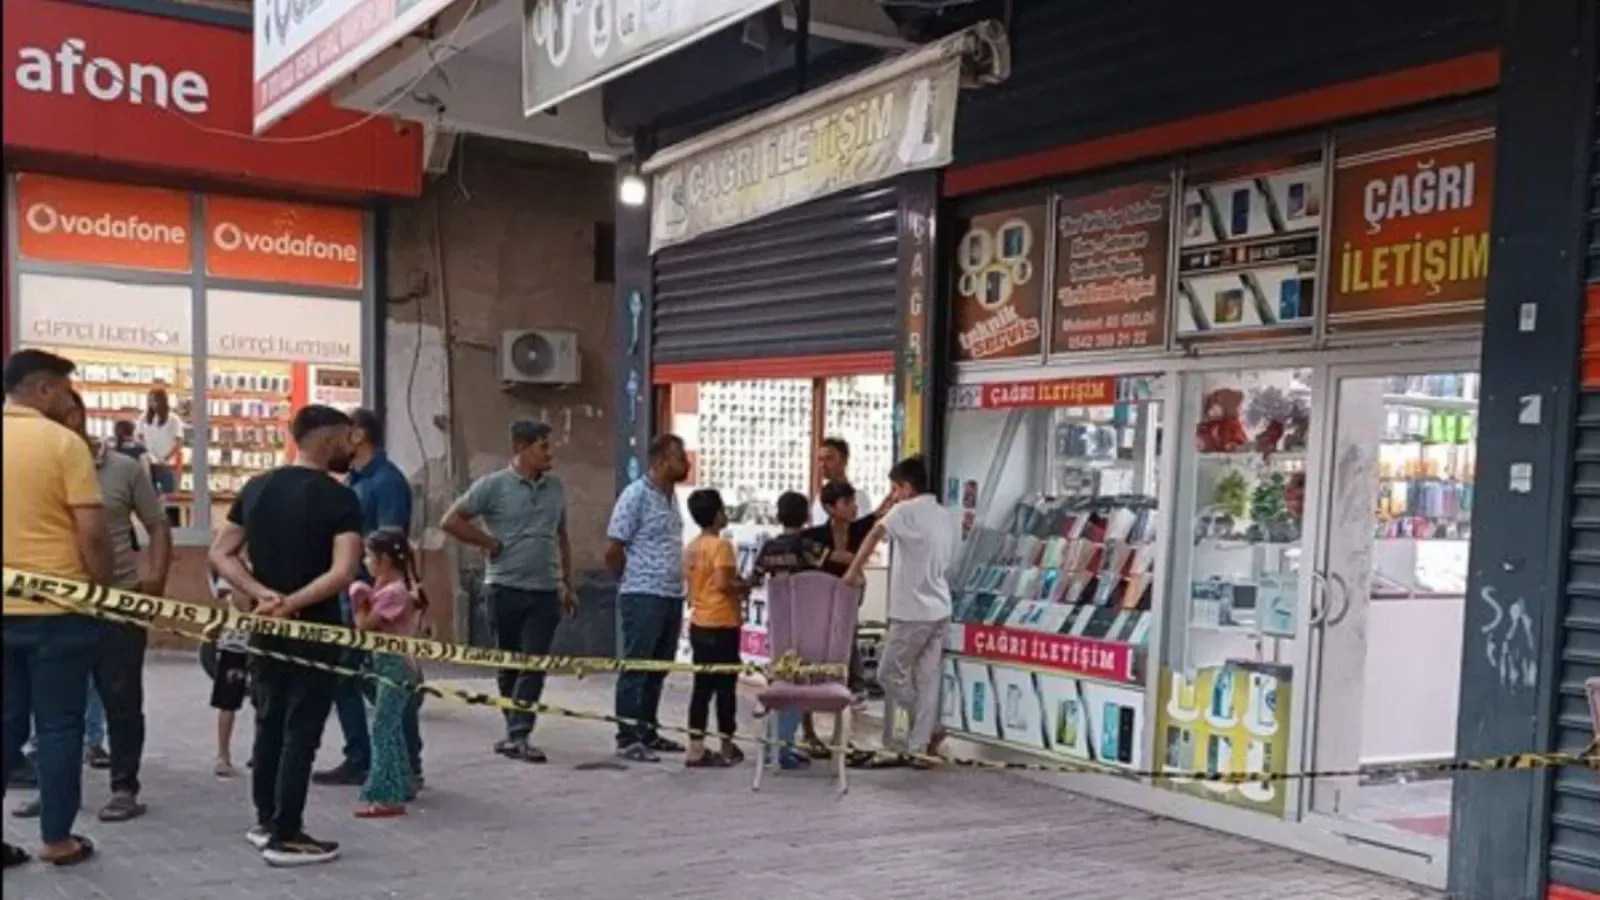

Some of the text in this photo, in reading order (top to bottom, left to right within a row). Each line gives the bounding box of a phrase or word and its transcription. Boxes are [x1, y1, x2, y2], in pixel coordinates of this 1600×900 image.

[15, 38, 209, 113] afone
[1364, 158, 1475, 234] ÇAĞRI
[60, 213, 186, 244] vodafone
[244, 230, 357, 262] vodafone
[1340, 226, 1490, 296] İLETİŞİM
[989, 378, 1105, 405] ÇAĞRI İLETİŞİM
[974, 630, 1115, 671] ÇAĞRI İLETİŞİM
